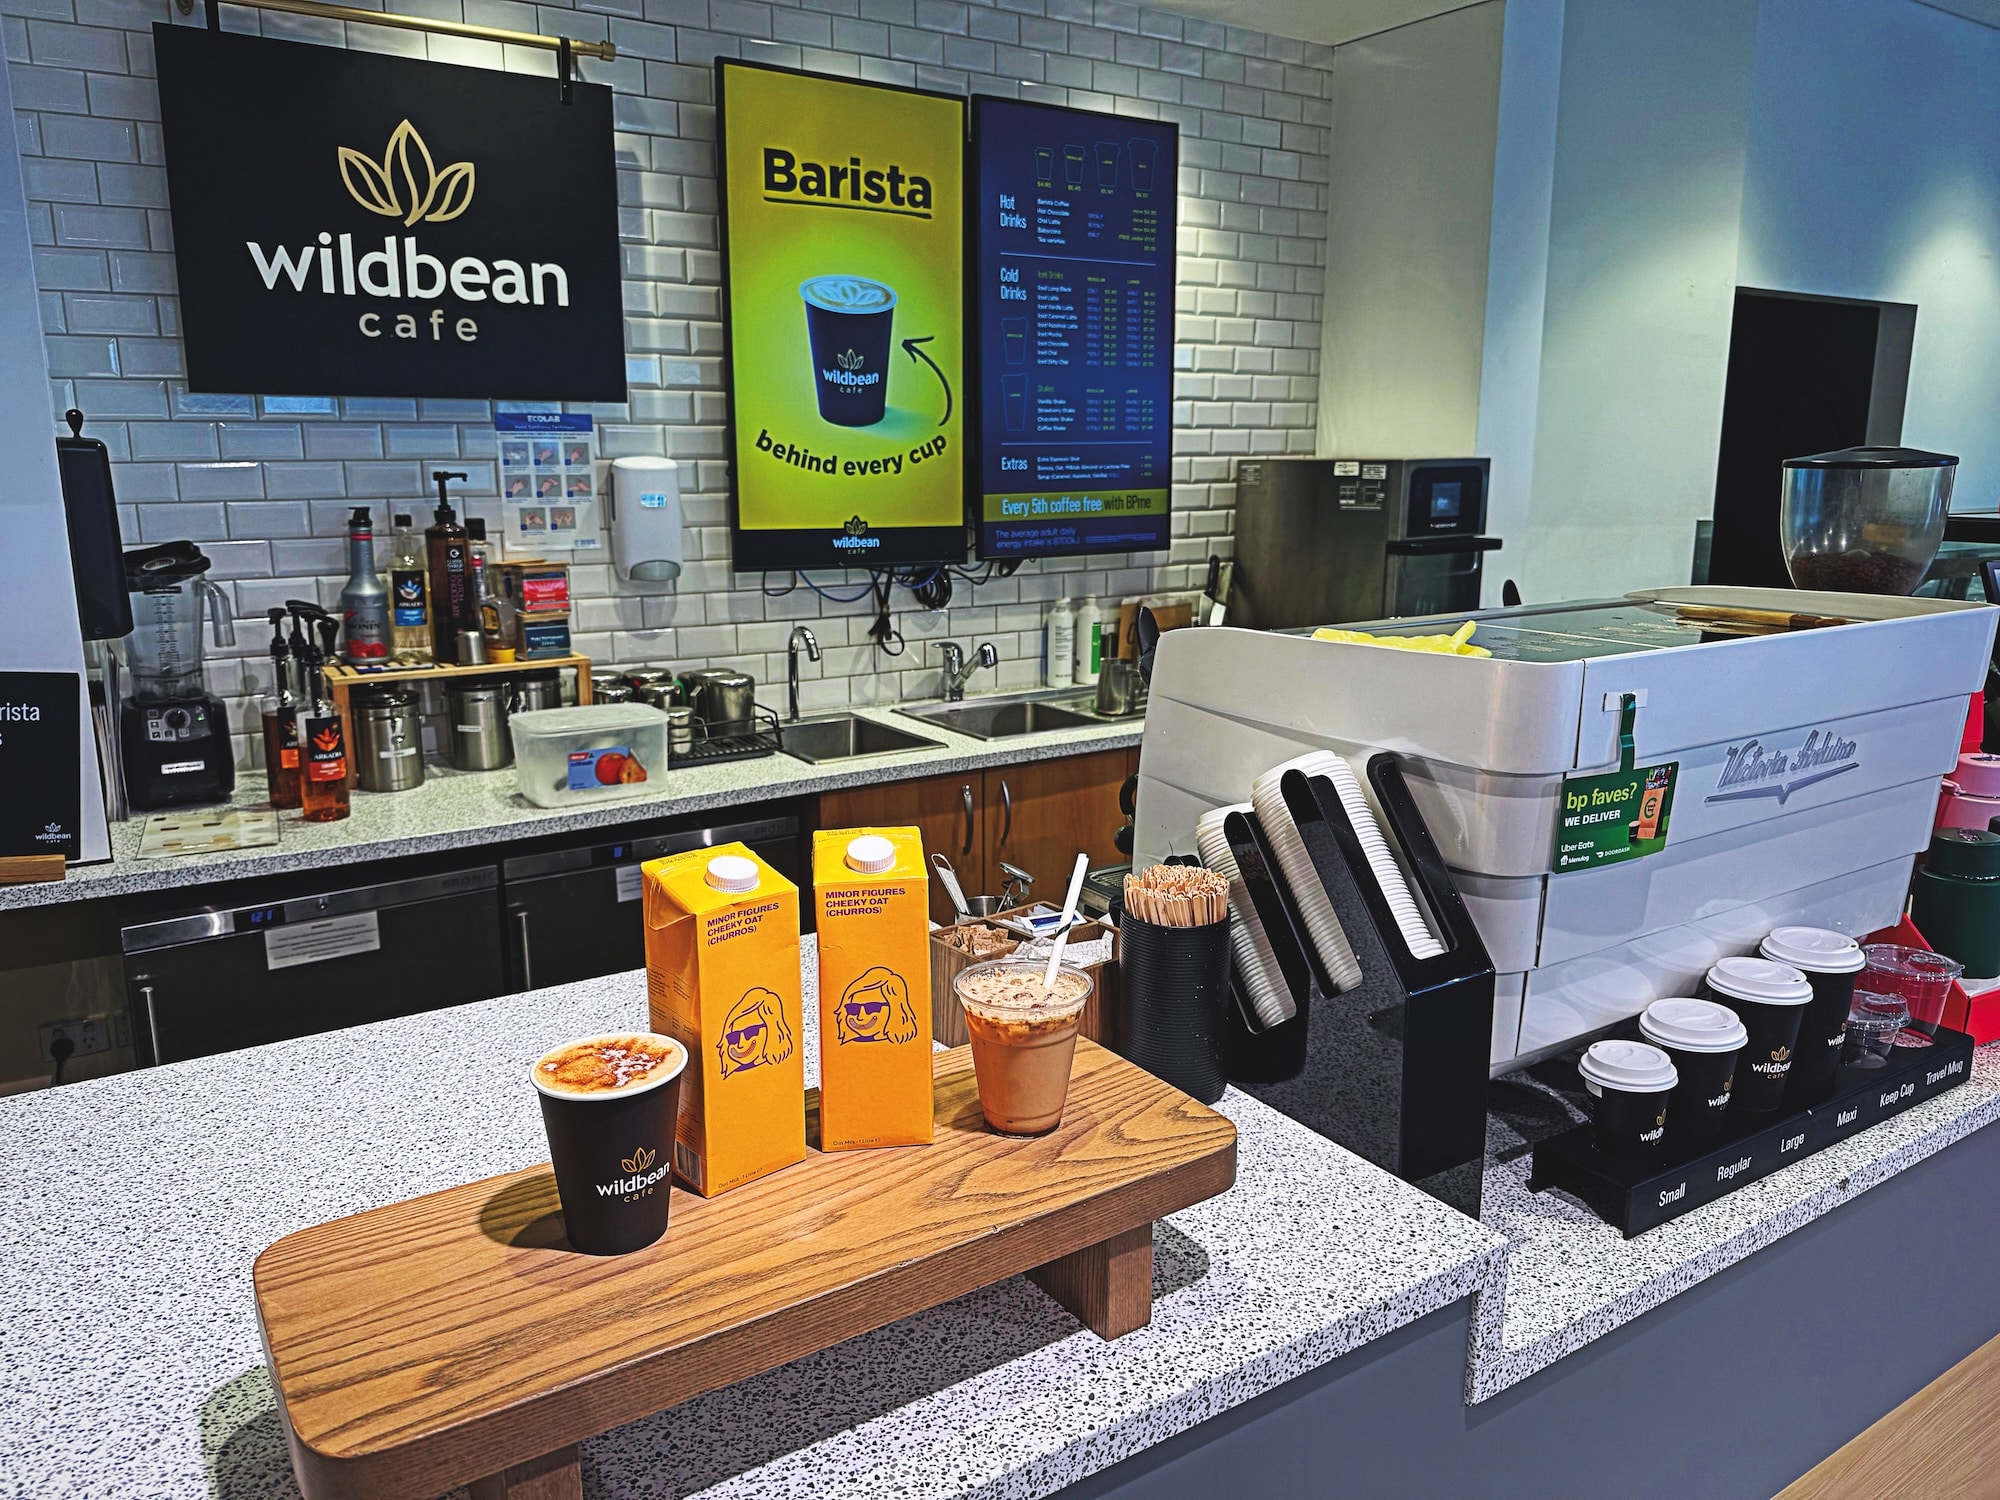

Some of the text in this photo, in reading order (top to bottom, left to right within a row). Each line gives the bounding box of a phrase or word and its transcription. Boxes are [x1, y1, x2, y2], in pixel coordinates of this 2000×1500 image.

[763, 147, 932, 210] Barista
[999, 194, 1016, 211] Hot
[999, 212, 1027, 229] Drinks
[246, 231, 569, 307] wildbean
[1000, 267, 1019, 283] Cold
[1000, 285, 1027, 301] Drinks
[358, 309, 478, 342] cafe
[822, 369, 880, 386] wildbean
[839, 386, 864, 394] cafe
[527, 415, 561, 423] ECOLAB
[755, 428, 947, 477] behind every cup
[1001, 457, 1028, 471] Extras
[1002, 494, 1151, 517] Every 5th coffee free with BPme
[995, 527, 1077, 540] The average adult daily
[832, 536, 880, 549] wildbean
[996, 541, 1021, 550] energy
[1023, 537, 1045, 547] intake
[314, 751, 343, 760] ARKADIA
[1716, 729, 1857, 788] Victoria Arduino
[1566, 782, 1638, 813] bp faves?
[1564, 809, 1621, 828] WE DELIVER
[35, 832, 72, 841] wildbean
[1561, 840, 1594, 853] Uber Eats
[1604, 846, 1631, 857] DOORDASH
[1568, 855, 1590, 864] Menulog
[825, 887, 906, 899] MINOR FIGURES
[825, 897, 889, 908] CHEEKY OAT
[707, 902, 780, 928] MINOR FIGURES
[825, 906, 882, 918] (CHURROS)
[707, 914, 764, 937] CHEEKY OAT
[707, 925, 757, 947] (CHURROS)
[1926, 1060, 1964, 1086] Travel Mug
[1879, 1082, 1915, 1108] Keep Cup
[1836, 1106, 1858, 1127] Maxi
[1780, 1133, 1805, 1153] Large
[1717, 1156, 1752, 1182] Regular
[596, 1161, 671, 1198] wildbean
[718, 1179, 729, 1189] Oat
[729, 1177, 739, 1185] Milk
[623, 1187, 654, 1203] cafe
[1658, 1182, 1686, 1207] Small
